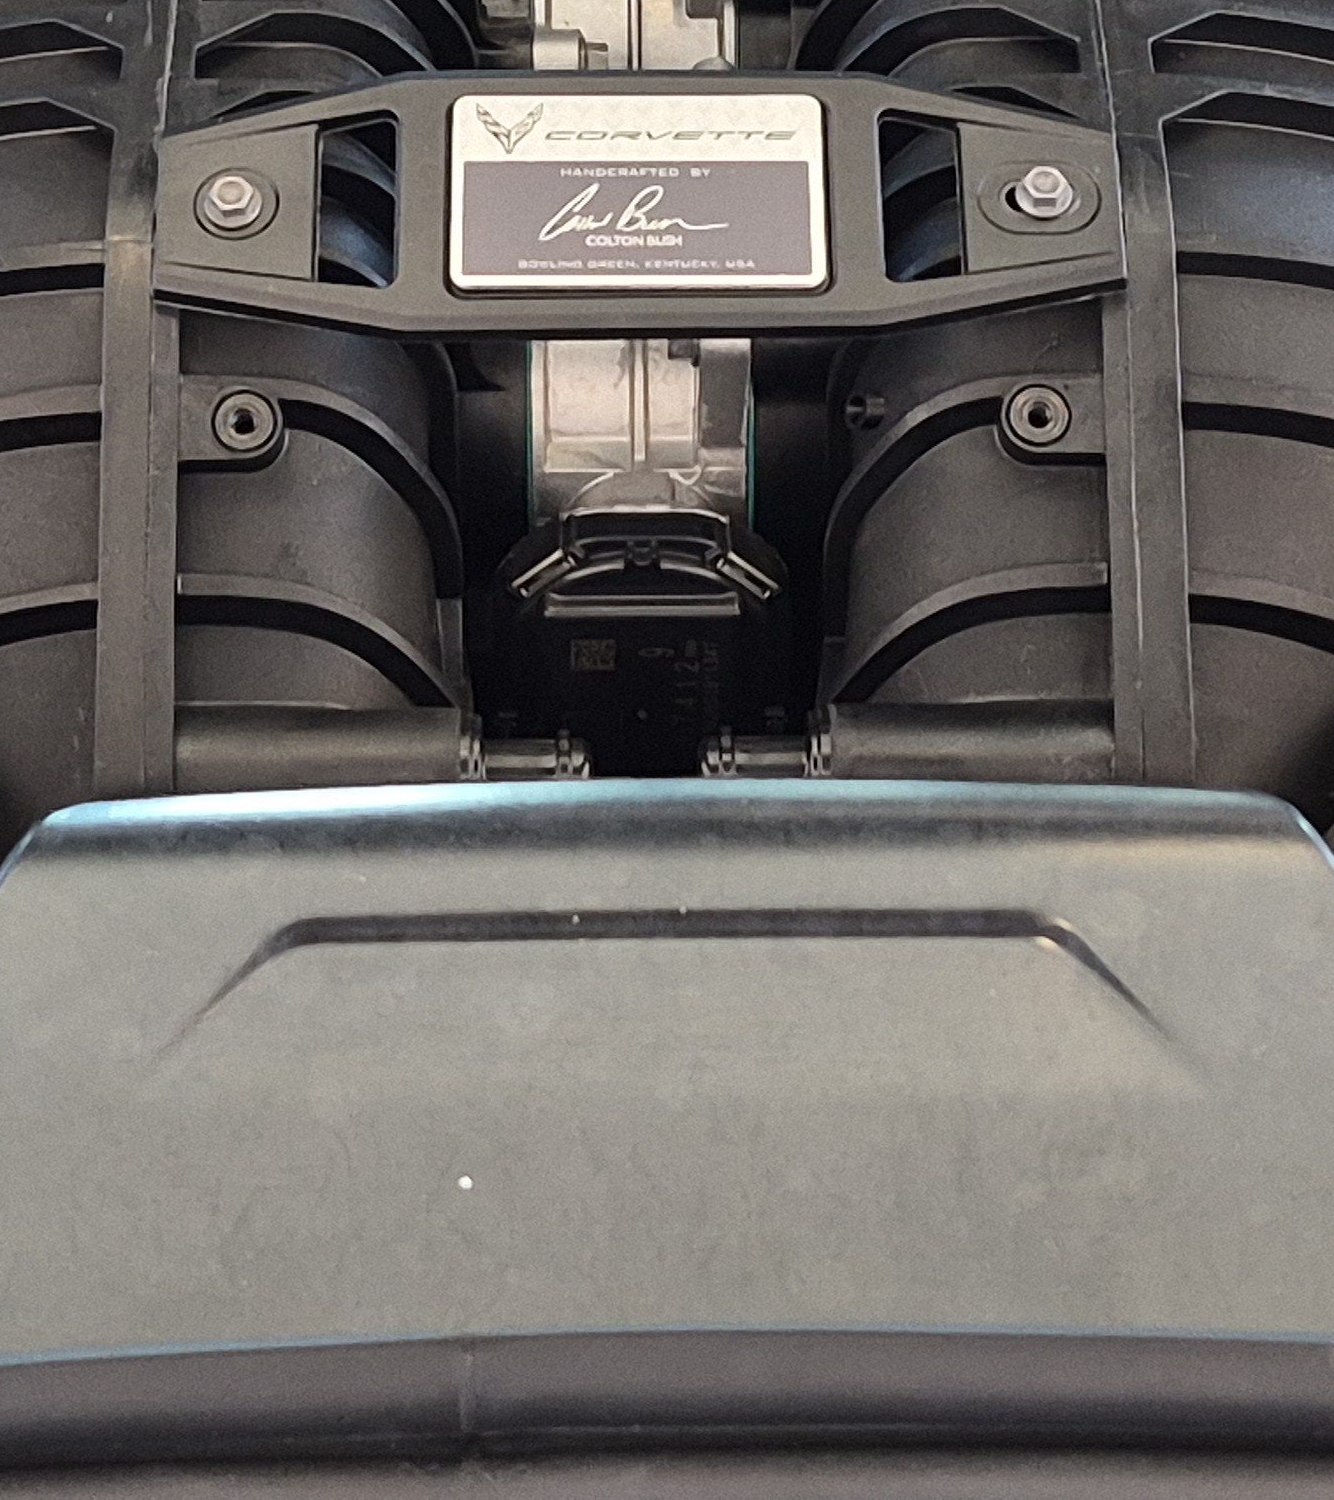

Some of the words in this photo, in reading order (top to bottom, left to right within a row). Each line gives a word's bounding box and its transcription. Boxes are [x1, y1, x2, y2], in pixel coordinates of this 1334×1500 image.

[544, 130, 798, 140] CORVETTE
[559, 167, 680, 177] HANDCRAFTED
[689, 167, 711, 177] BY
[585, 234, 645, 247] COLTON
[725, 259, 756, 269] USA
